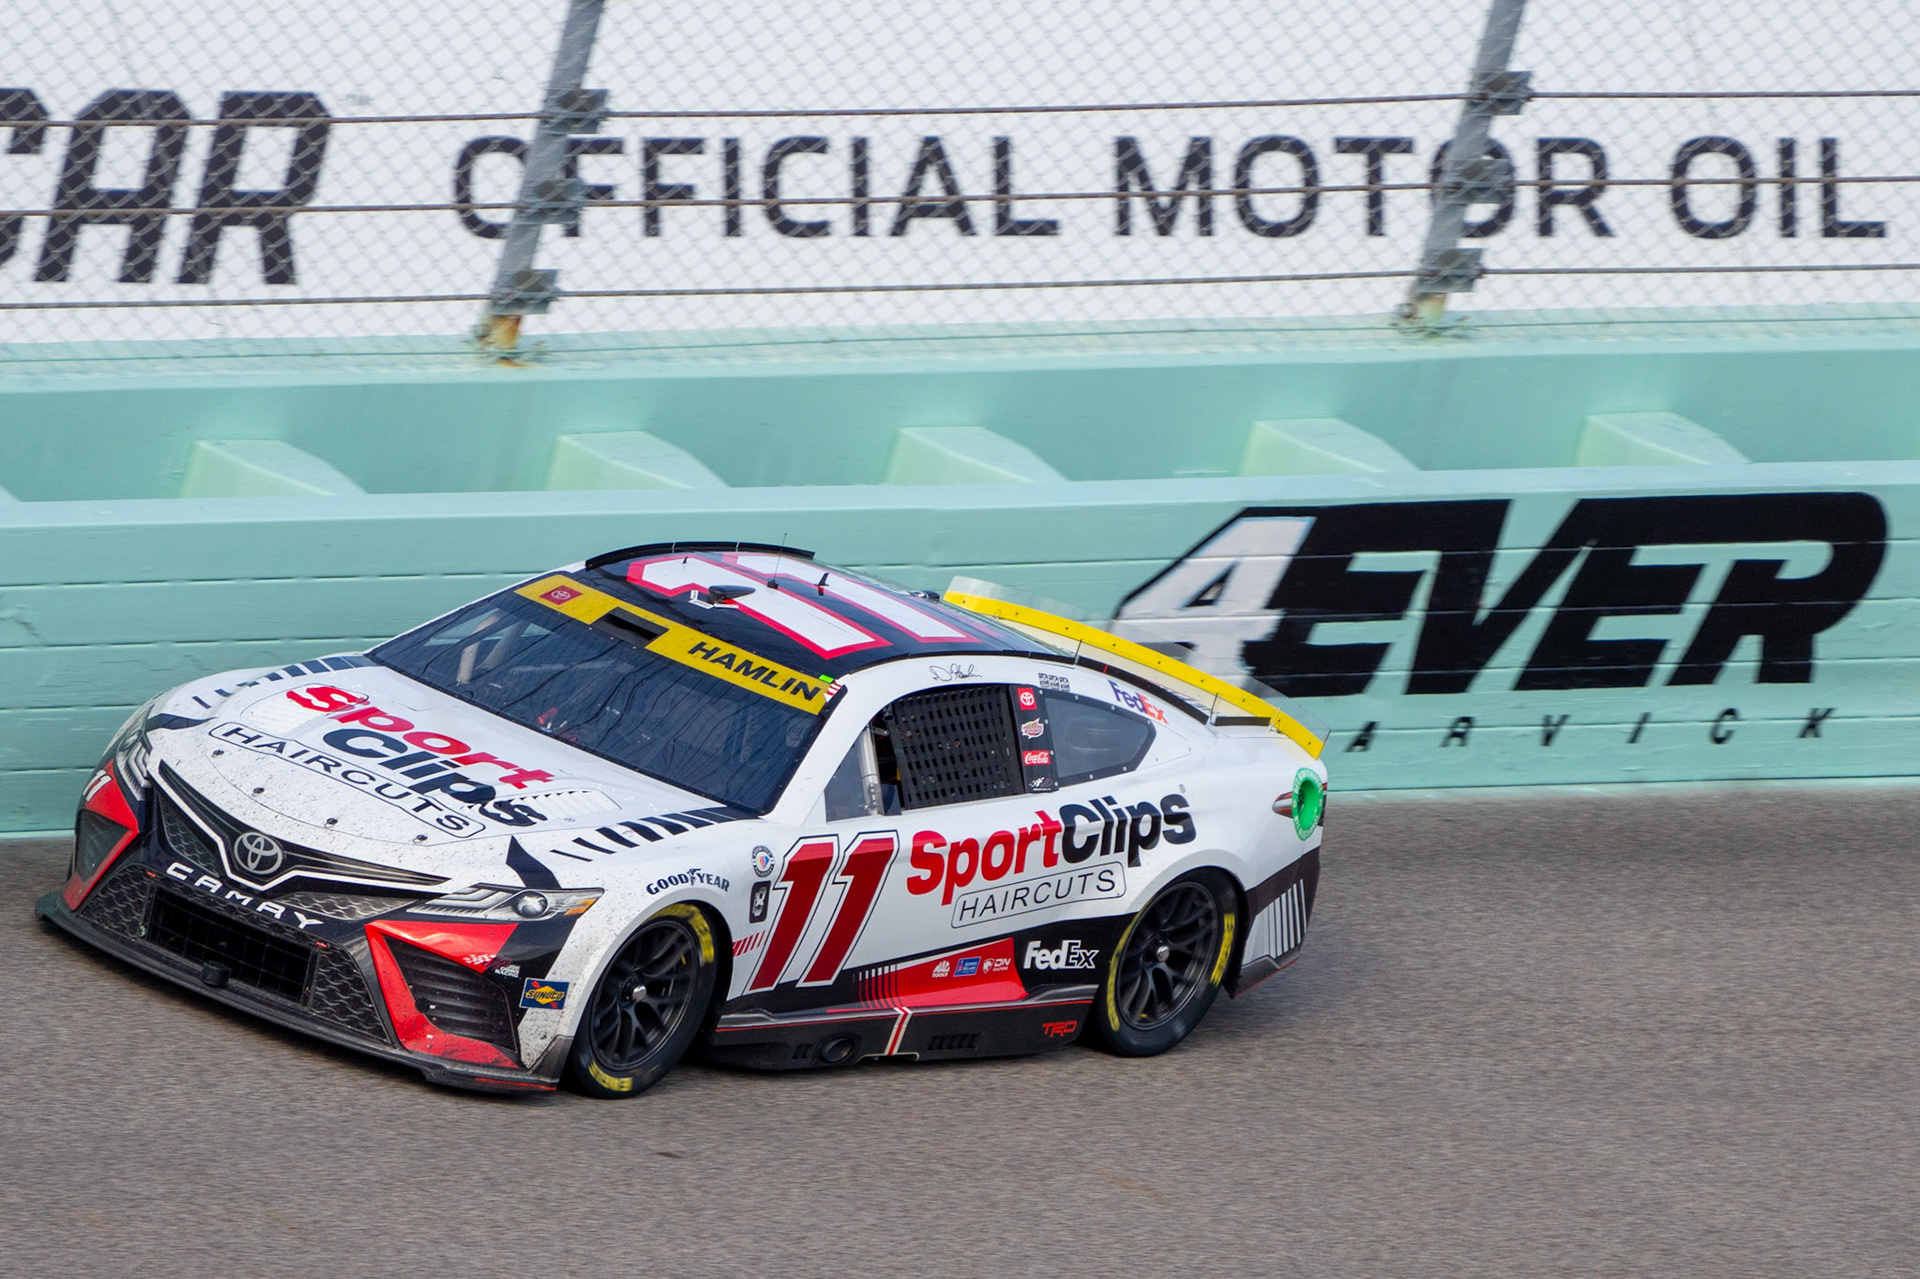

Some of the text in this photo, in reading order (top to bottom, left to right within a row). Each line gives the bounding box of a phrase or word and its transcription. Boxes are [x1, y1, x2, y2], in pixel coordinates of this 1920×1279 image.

[455, 136, 1059, 239] OFFICIAL
[1115, 135, 1615, 238] MOTOR
[1670, 136, 1886, 239] OIL
[1113, 491, 1887, 697] 4EVER
[687, 641, 821, 701] HAMLIN
[1107, 679, 1169, 725] FedEx
[286, 686, 554, 789] Sport
[1344, 708, 1835, 752] ARVICK
[222, 727, 470, 831] HAIRCUTS
[322, 728, 548, 826] Clips
[166, 862, 324, 930] CAMRY
[745, 831, 899, 993] 11
[959, 869, 1116, 921] HAIRCUTS
[1023, 940, 1100, 969] FedEx
[527, 990, 565, 999] SUNOCO
[1042, 1020, 1077, 1038] TRD
